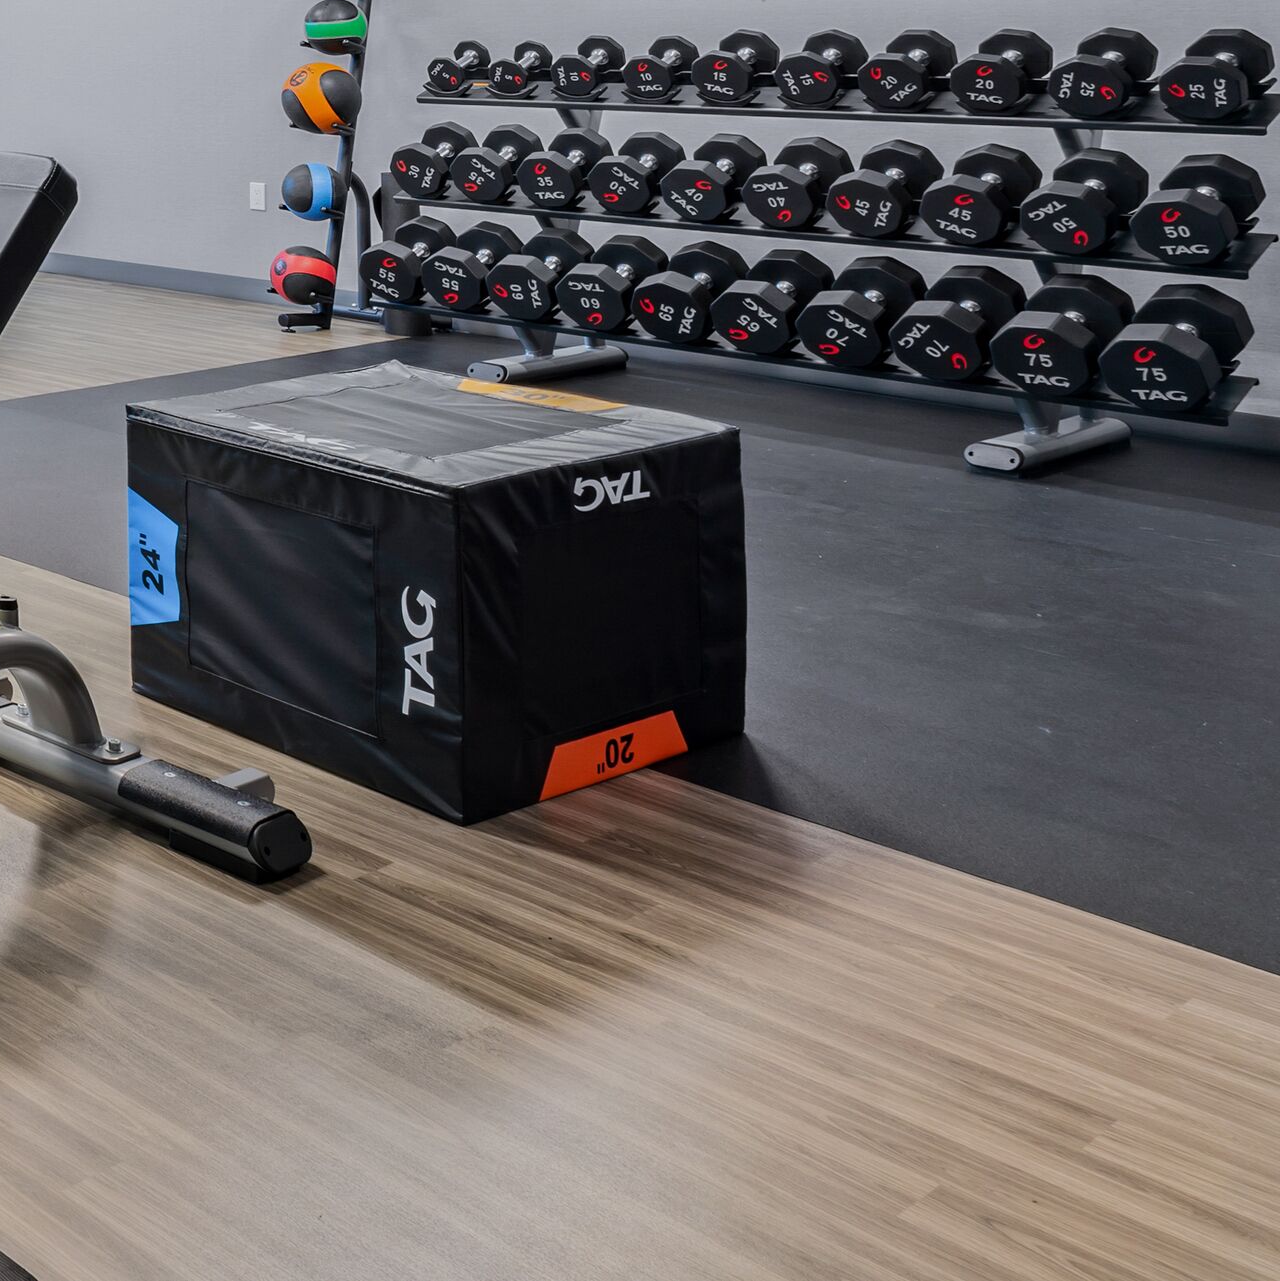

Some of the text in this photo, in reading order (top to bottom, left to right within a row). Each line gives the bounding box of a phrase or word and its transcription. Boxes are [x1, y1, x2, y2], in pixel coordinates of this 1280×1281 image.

[431, 63, 443, 76] TAG
[494, 67, 502, 81] TAG
[557, 66, 566, 86] TAG
[570, 72, 579, 81] 10
[640, 73, 652, 81] 10
[713, 72, 726, 81] 15
[783, 70, 799, 95] TAG
[800, 74, 814, 85] 15
[881, 76, 897, 89] 20
[976, 79, 993, 89] 20
[1059, 72, 1073, 98] TAG
[704, 83, 734, 95] TAG
[890, 83, 917, 101] TAG
[1080, 82, 1095, 97] 25
[1189, 84, 1205, 99] 25
[1214, 79, 1227, 107] TAG
[967, 93, 1003, 104] TAG
[409, 165, 419, 178] 30
[471, 158, 496, 180] TAG
[421, 167, 434, 187] TAG
[468, 172, 484, 185] 35
[537, 177, 553, 186] 35
[612, 166, 640, 190] TAG
[610, 182, 626, 195] 30
[753, 182, 788, 192] TAG
[685, 189, 703, 201] 40
[768, 197, 785, 207] 40
[670, 191, 698, 216] TAG
[855, 200, 870, 216] 45
[1028, 201, 1066, 220] TAG
[874, 201, 892, 227] TAG
[949, 208, 971, 221] 45
[936, 219, 976, 238] TAG
[1053, 218, 1077, 232] 50
[1164, 226, 1190, 238] 50
[1160, 245, 1209, 255] TAG
[379, 268, 395, 282] 55
[434, 262, 466, 277] TAG
[370, 278, 400, 300] TAG
[442, 278, 458, 291] 55
[512, 284, 523, 300] 60
[568, 281, 604, 292] TAG
[531, 279, 542, 308] TAG
[581, 298, 600, 309] 60
[659, 304, 674, 321] 65
[679, 307, 696, 333] TAG
[742, 297, 778, 328] TAG
[737, 315, 759, 332] 65
[826, 310, 866, 338] TAG
[826, 328, 848, 346] 70
[898, 323, 930, 348] TAG
[926, 340, 949, 357] 70
[1024, 353, 1052, 367] 75
[1018, 373, 1069, 387] TAG
[1136, 368, 1166, 381] 75
[1131, 390, 1187, 401] TAG
[573, 469, 651, 512] TAG
[139, 533, 165, 595] 24"
[400, 585, 437, 716] TAG
[597, 733, 635, 775] 20"
